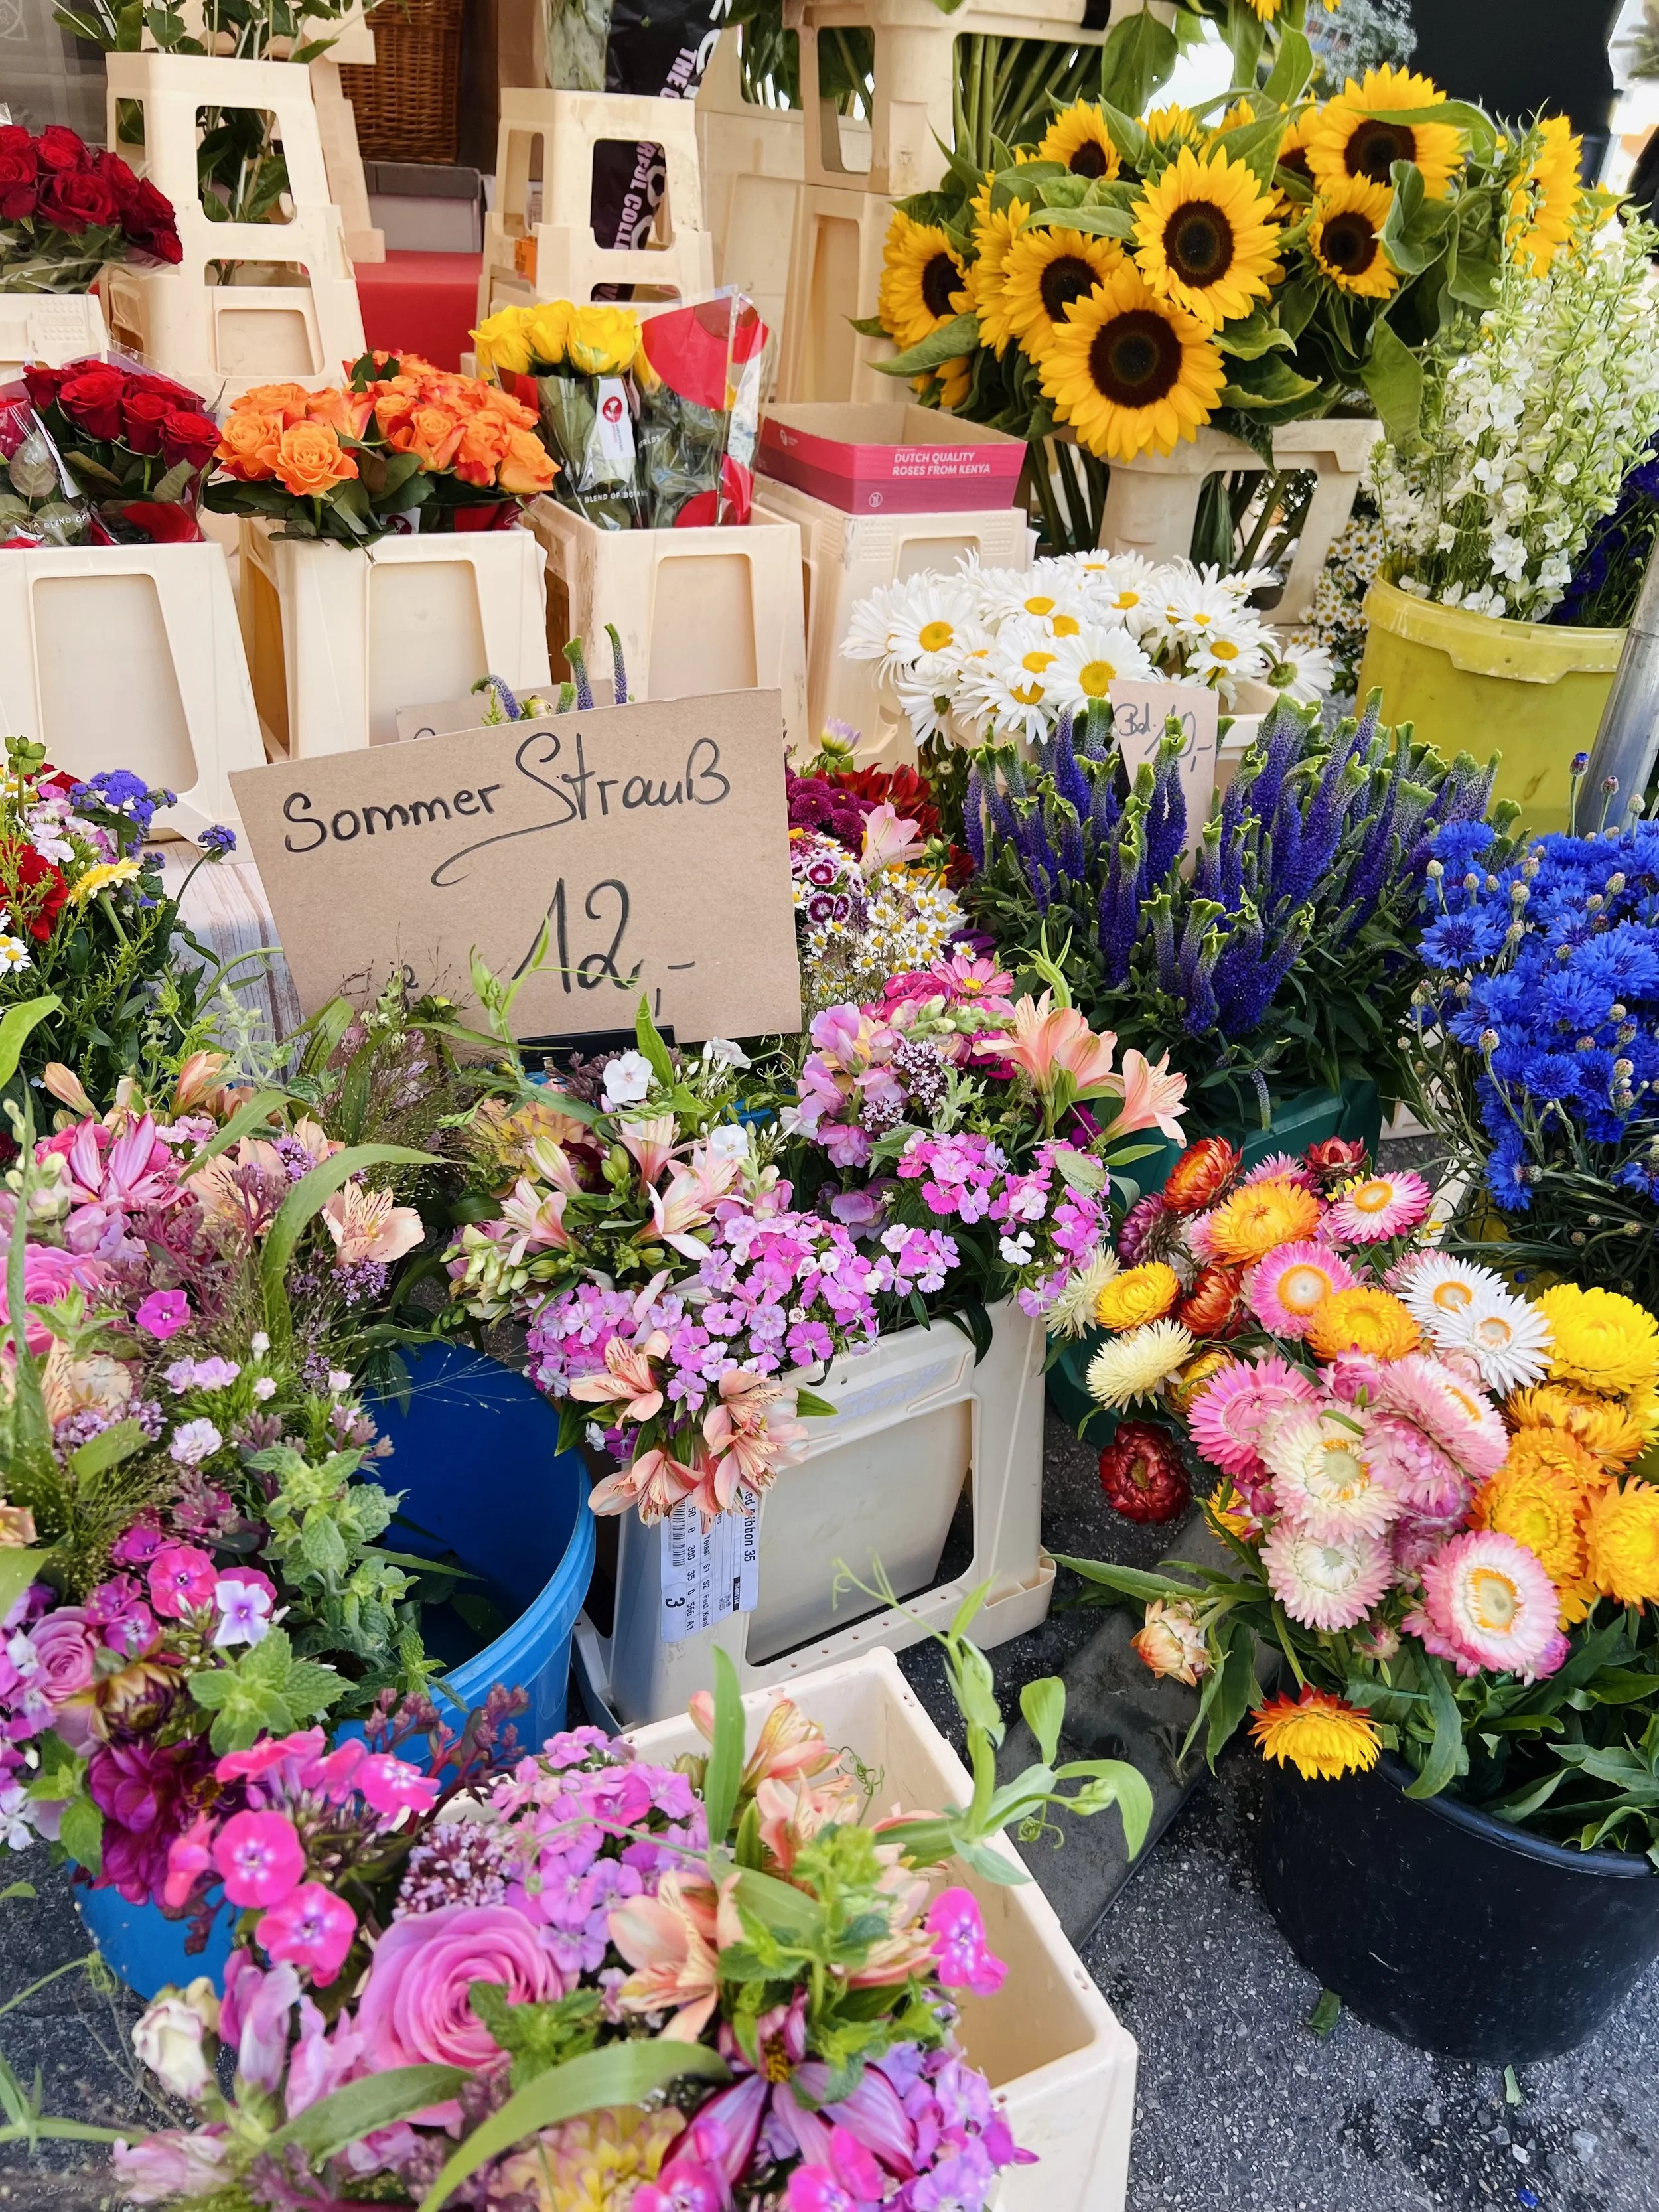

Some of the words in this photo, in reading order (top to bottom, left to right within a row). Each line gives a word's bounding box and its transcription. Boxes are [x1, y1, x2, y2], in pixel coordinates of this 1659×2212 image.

[666, 47, 697, 89] THE
[630, 141, 657, 189] RFUL
[894, 453, 930, 463] DUTCH
[931, 451, 975, 464] QUALITY
[892, 465, 926, 476] ROSES
[927, 465, 957, 475] FROM
[958, 463, 990, 474] KENYA
[584, 493, 608, 504] BLEND
[43, 517, 71, 529] BLEND
[283, 783, 507, 853] Sommer
[431, 731, 731, 887] Strauß
[744, 1491, 755, 1506] ed
[688, 1506, 697, 1518] 50
[687, 1545, 696, 1561] 300
[744, 1550, 756, 1562] 35
[703, 1563, 711, 1573] S1
[687, 1570, 695, 1581] 35
[703, 1580, 710, 1590] S2
[665, 1597, 685, 1608] 3
[686, 1620, 695, 1631] A1
